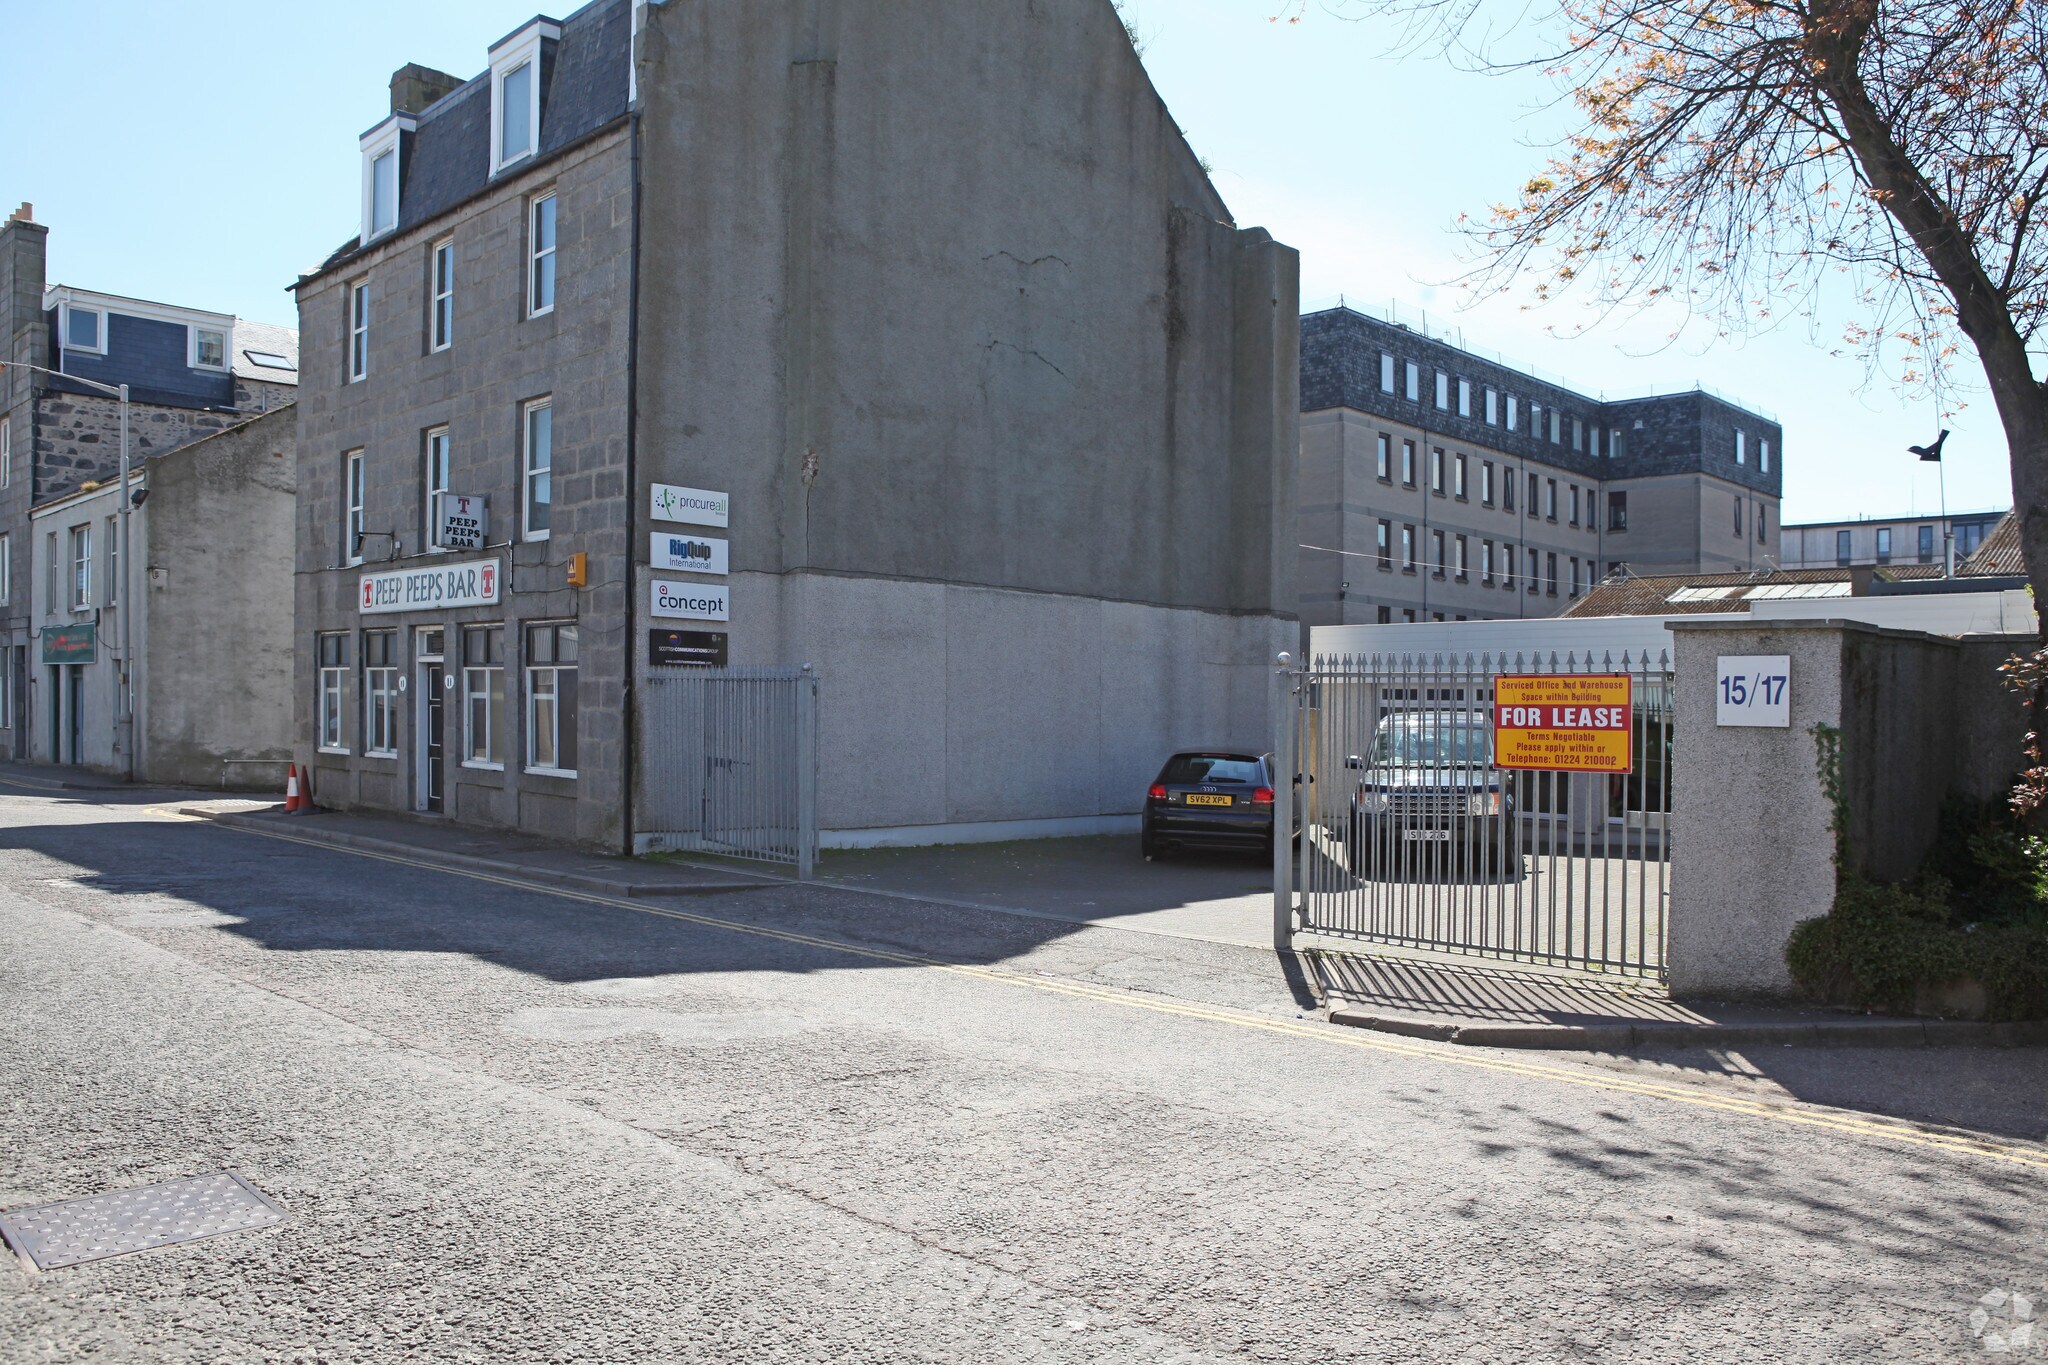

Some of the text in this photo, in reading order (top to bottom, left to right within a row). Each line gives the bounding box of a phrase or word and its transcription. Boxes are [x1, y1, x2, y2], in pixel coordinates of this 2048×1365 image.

[680, 497, 726, 512] procureall
[449, 516, 478, 528] PEEP
[445, 526, 481, 538] PEEPS
[451, 537, 474, 548] BAR
[669, 538, 712, 561] RigQuip
[669, 558, 712, 570] International
[375, 578, 403, 605] PEEP
[406, 572, 443, 603] PEEPS
[447, 569, 477, 599] BAR
[659, 596, 724, 615] concept
[1501, 681, 1623, 690] Serviced Office and Warehouse
[1720, 672, 1787, 708] 15/17
[1521, 693, 1602, 703] Space within Building
[1501, 707, 1623, 728] FOR LEASE
[1526, 732, 1596, 743] Terms Negotiable
[1516, 742, 1542, 752] Please
[1544, 744, 1566, 754] apply
[1569, 744, 1594, 753] within
[1506, 753, 1617, 766] Telephone: 01224 210002
[1190, 795, 1228, 804] SV62 XPL
